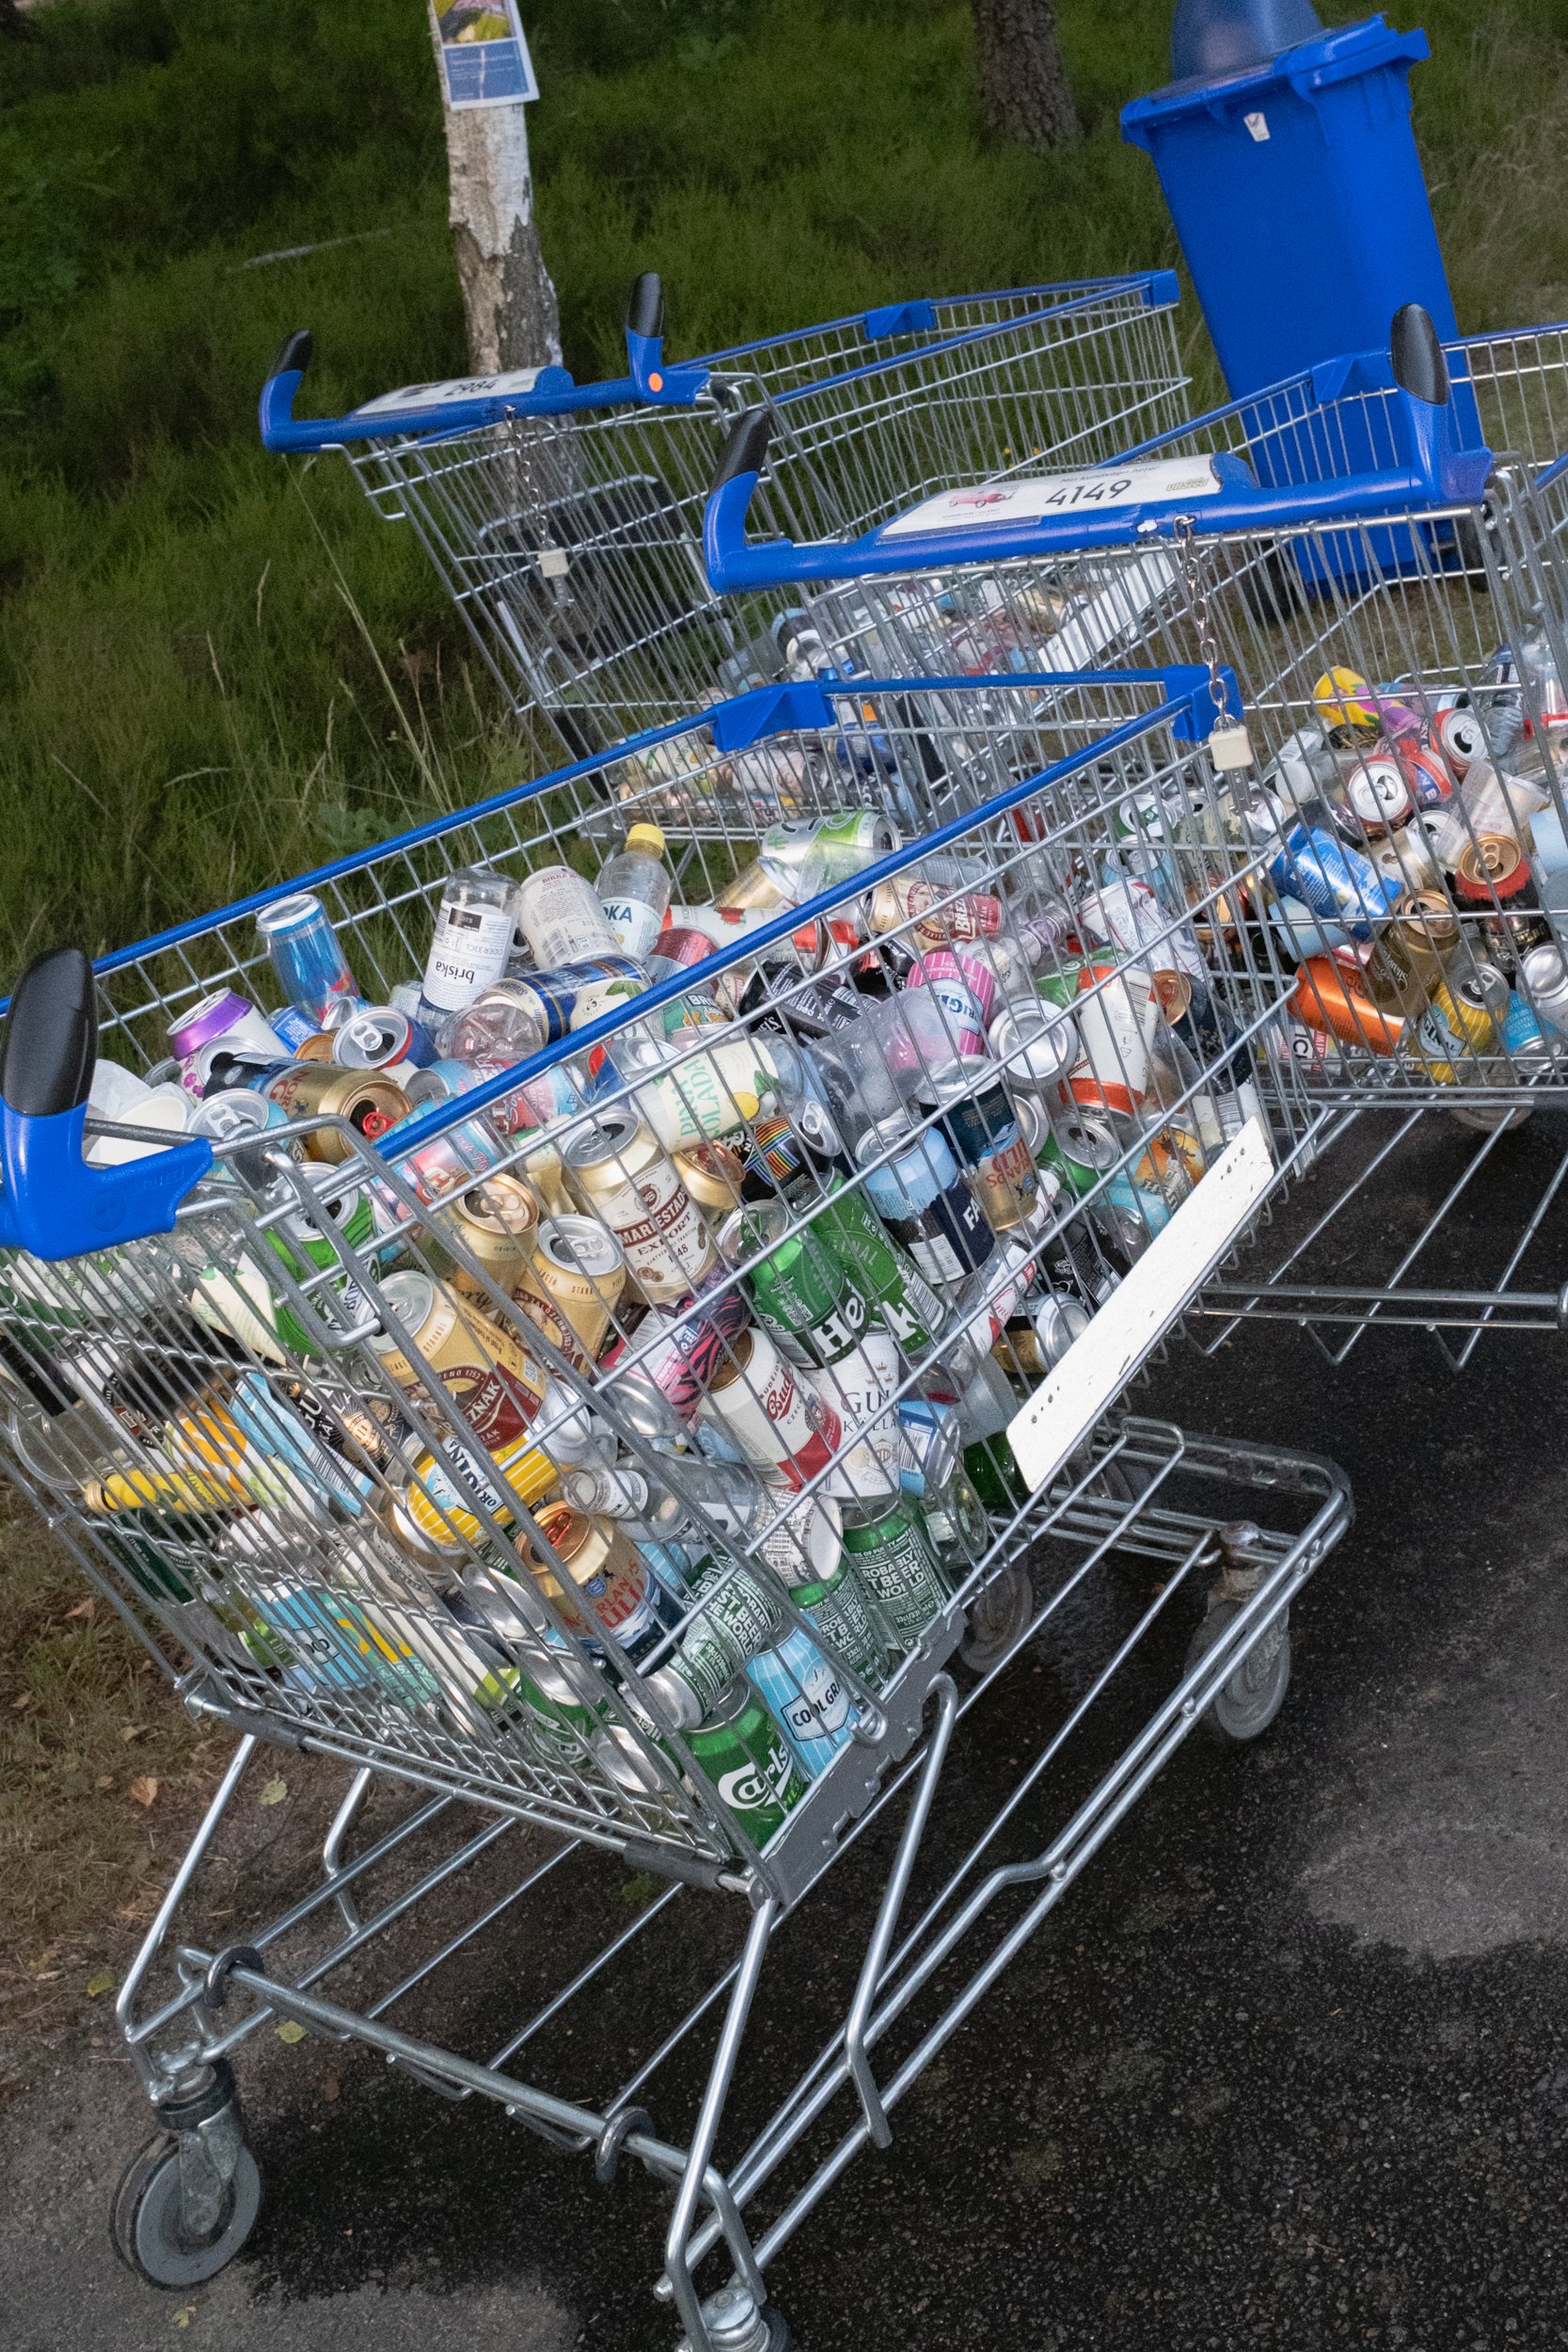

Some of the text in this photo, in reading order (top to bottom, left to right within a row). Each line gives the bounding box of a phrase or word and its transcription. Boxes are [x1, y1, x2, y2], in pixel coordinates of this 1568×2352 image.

[445, 378, 499, 397] 2984
[1044, 479, 1132, 506] 4149
[436, 960, 475, 984] briska
[668, 1243, 689, 1263] 148
[722, 1609, 753, 1656] WORLD
